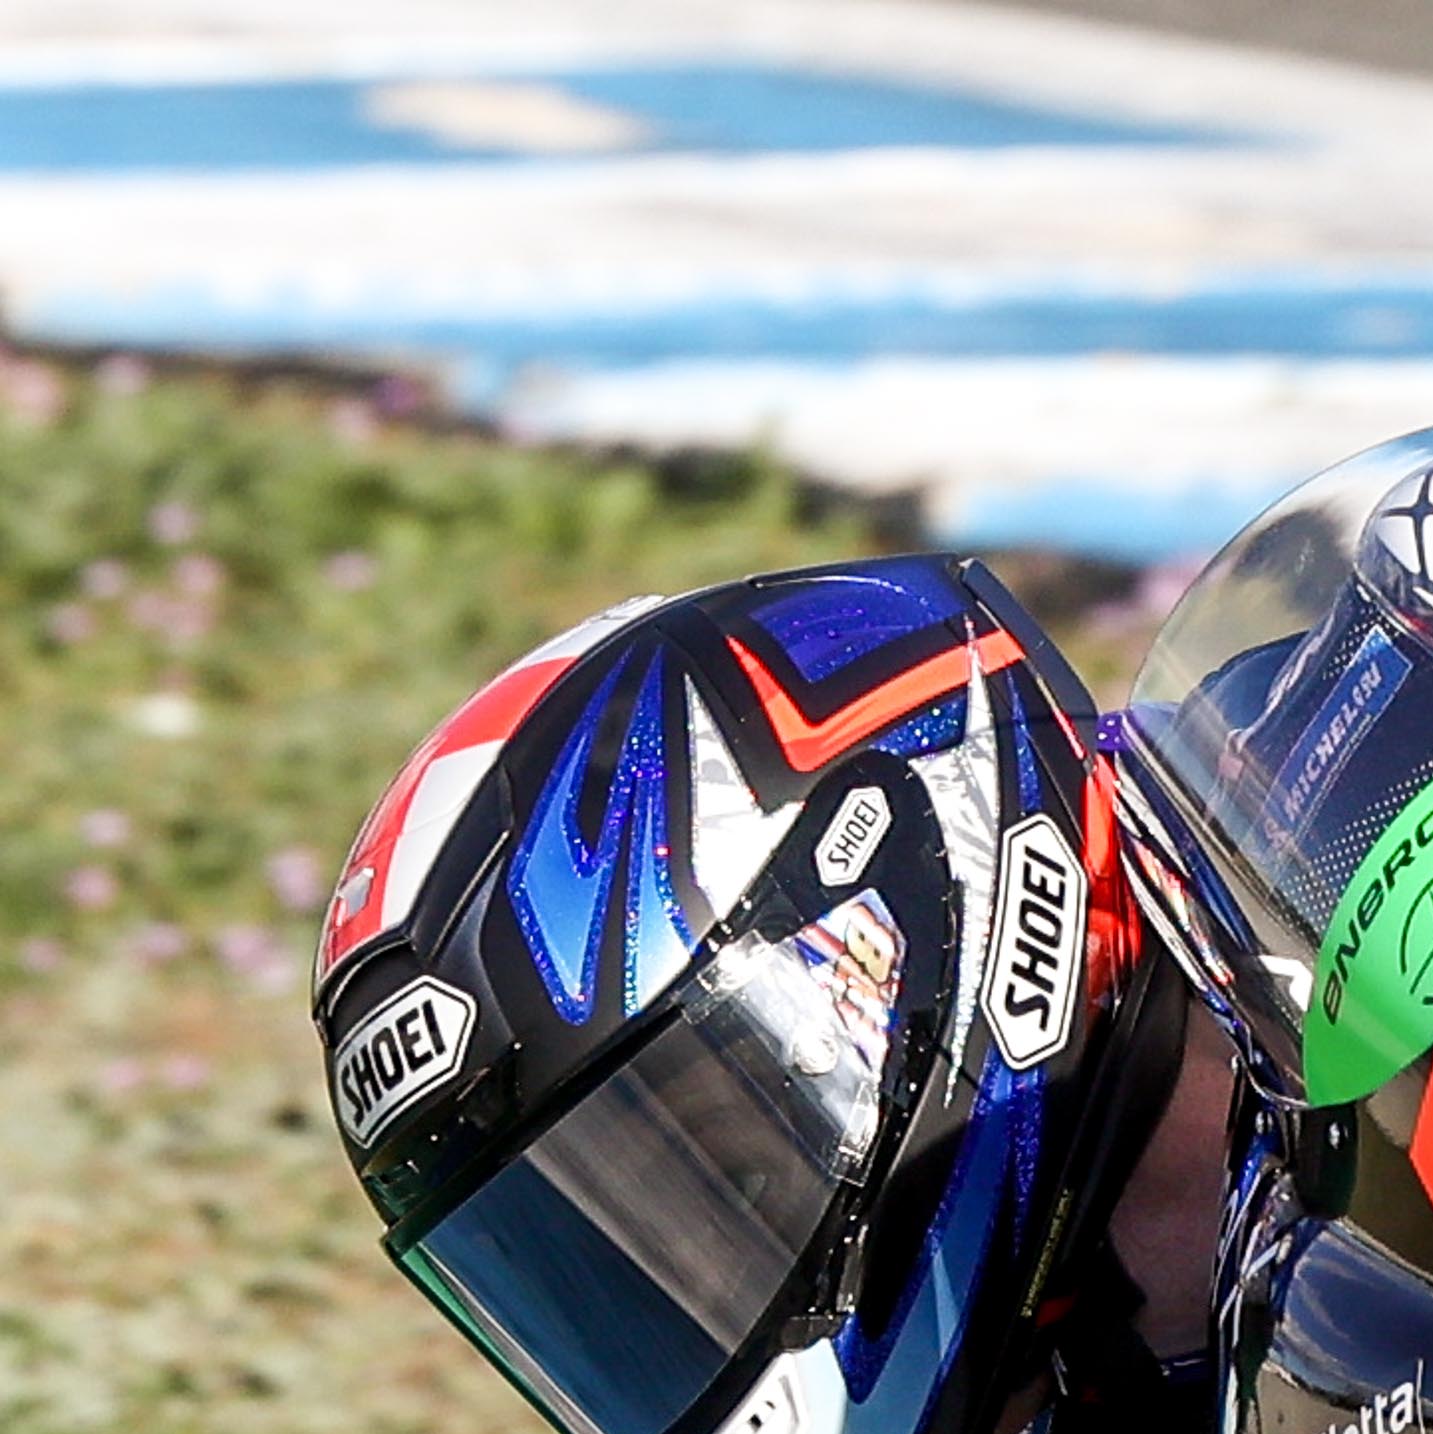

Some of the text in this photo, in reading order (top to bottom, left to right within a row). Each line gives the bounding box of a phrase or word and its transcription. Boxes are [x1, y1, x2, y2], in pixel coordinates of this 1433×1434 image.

[826, 793, 880, 875] SHOEI
[1005, 849, 1068, 1033] SHOEI
[340, 1000, 443, 1129] SHOEI
